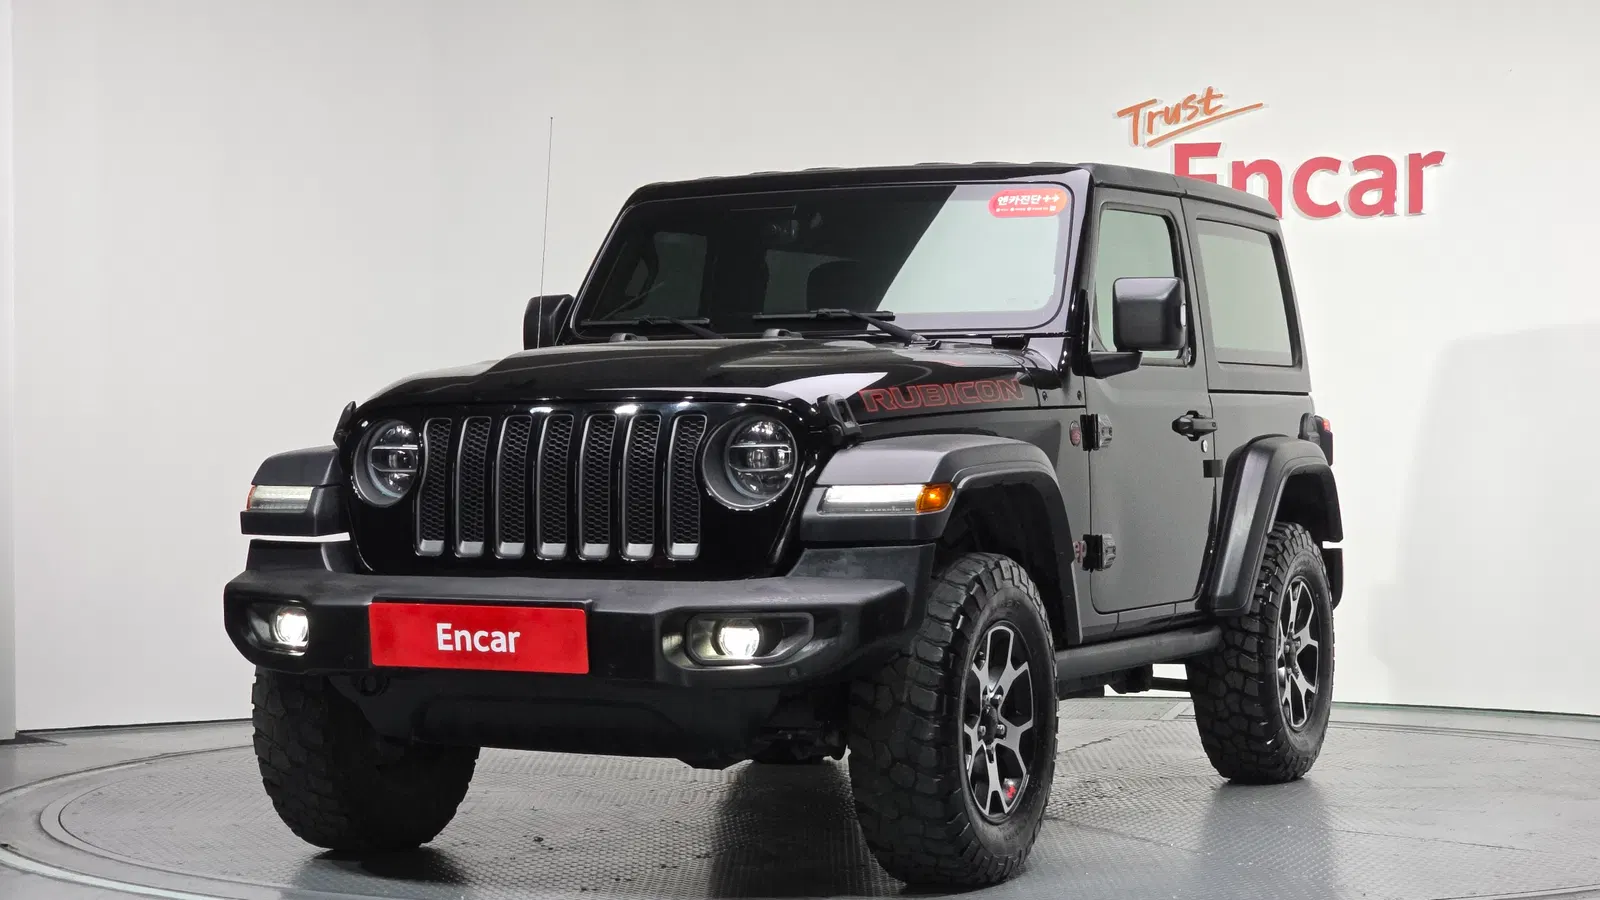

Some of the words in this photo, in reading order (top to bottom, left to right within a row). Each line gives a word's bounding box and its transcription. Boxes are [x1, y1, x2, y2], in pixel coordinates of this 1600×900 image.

[1116, 86, 1224, 146] Trust
[859, 378, 1025, 413] RUBICON
[436, 622, 521, 653] Encar
